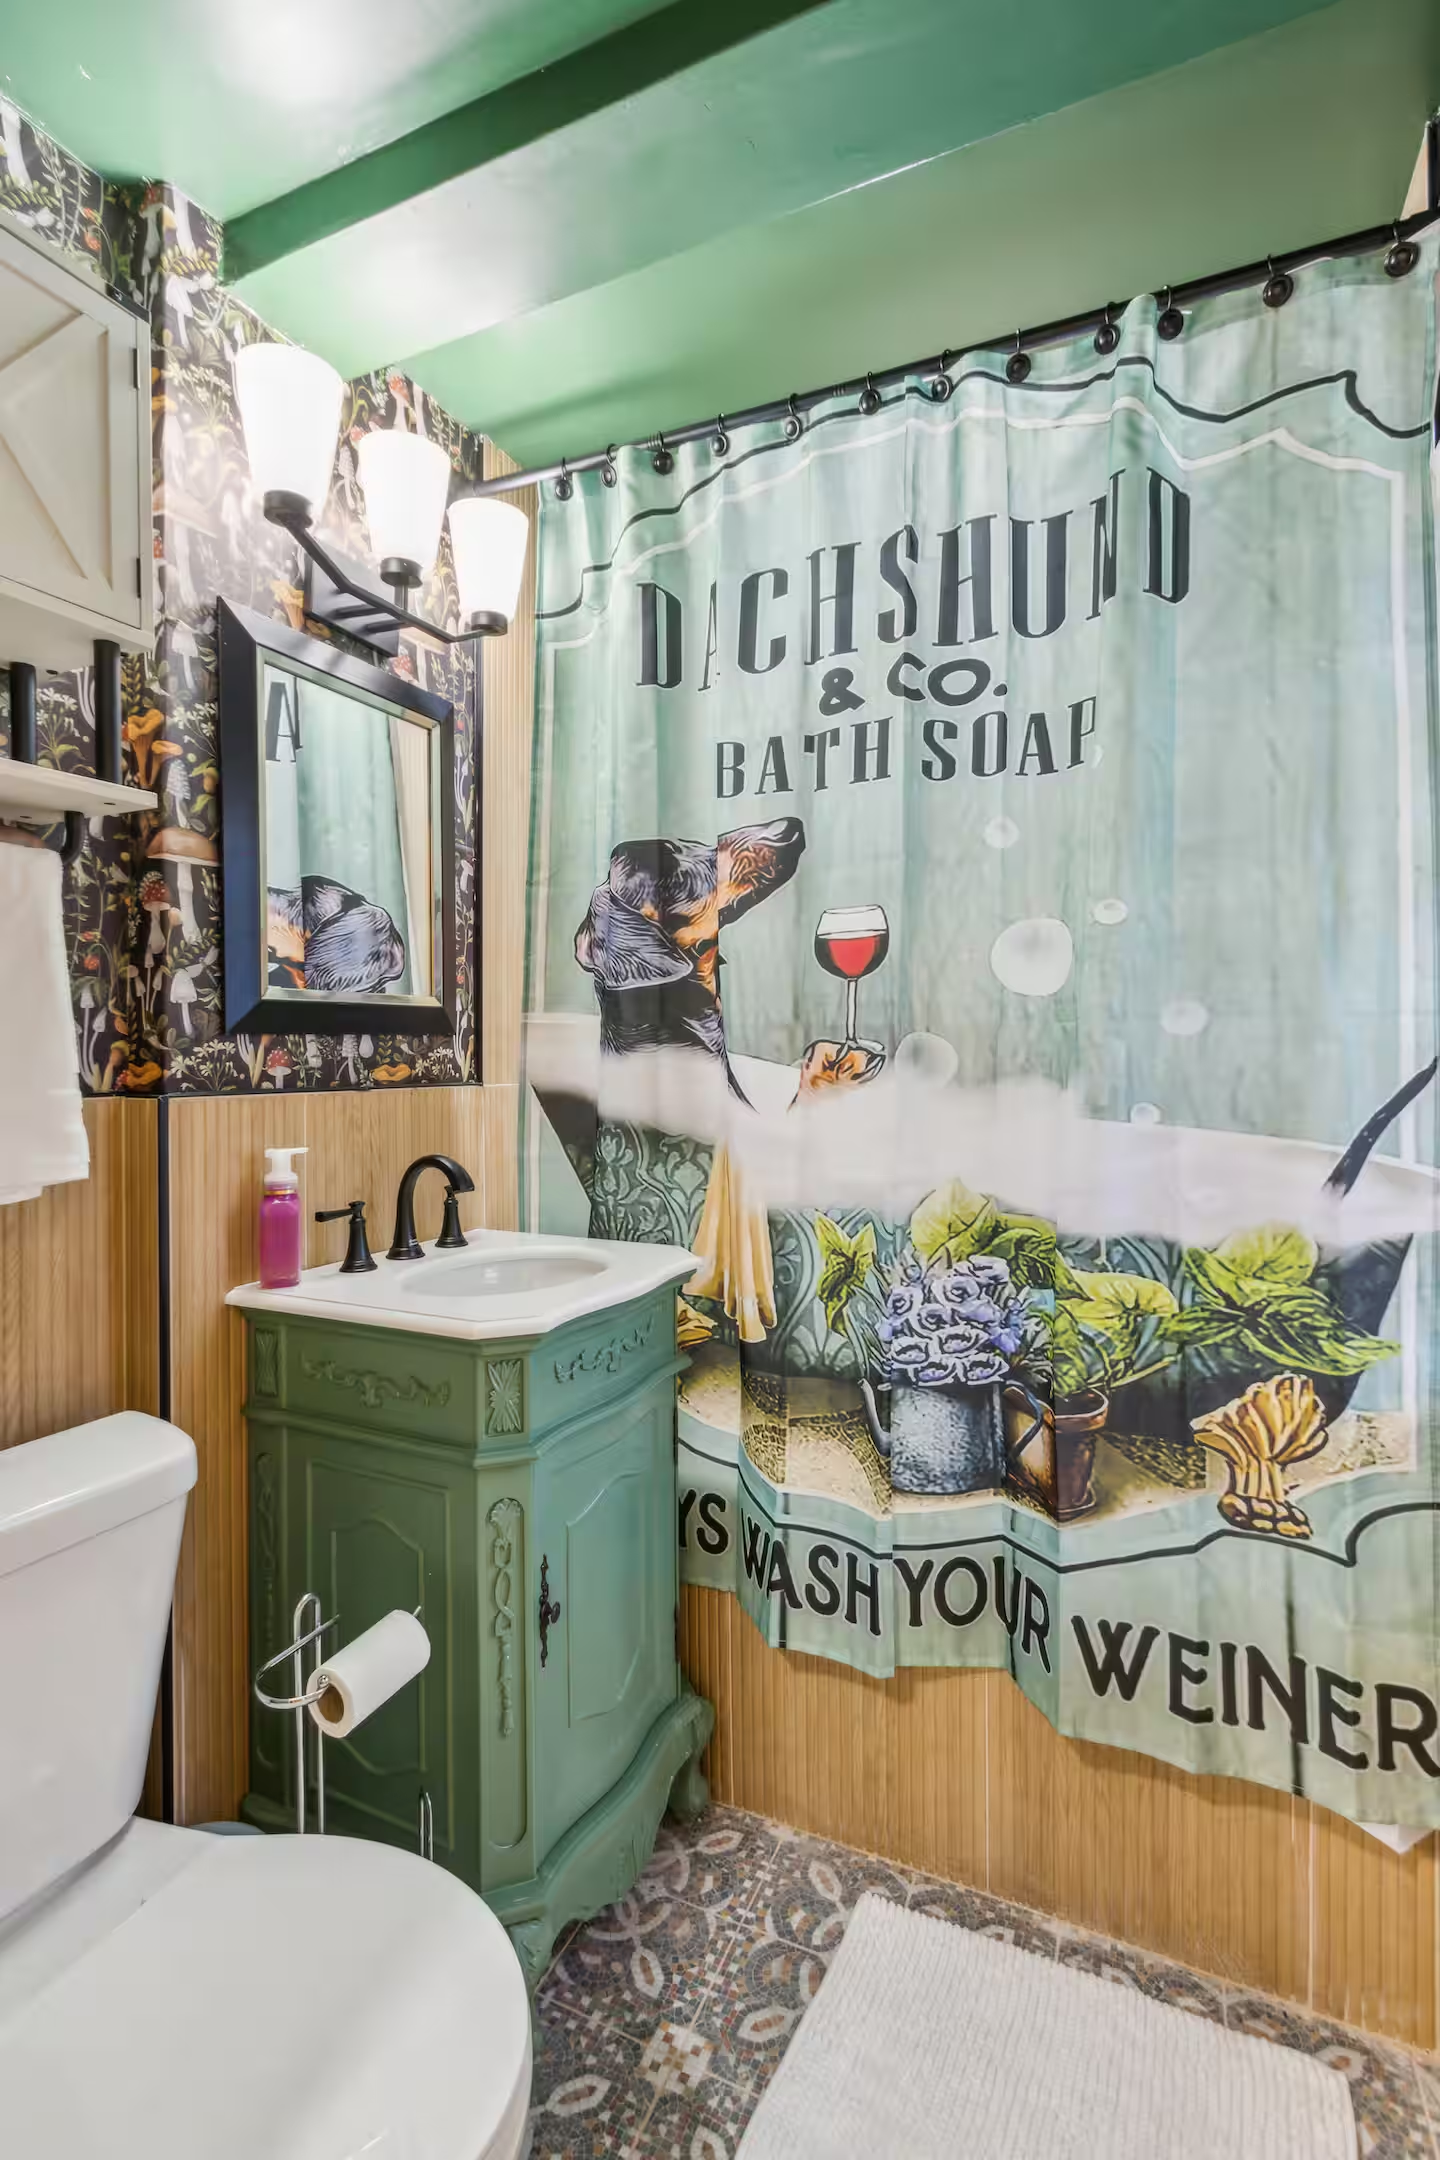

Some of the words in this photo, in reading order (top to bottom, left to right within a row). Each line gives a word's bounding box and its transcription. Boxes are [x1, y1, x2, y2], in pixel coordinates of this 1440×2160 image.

[635, 466, 1191, 692] DACHSHUND
[716, 716, 893, 799] BATH
[921, 696, 1097, 782] SOAP
[818, 667, 866, 716] &
[886, 651, 1008, 707] CO.
[740, 1507, 881, 1636] WASH
[892, 1555, 1052, 1674] YOUR
[1071, 1614, 1440, 1778] WEINER
